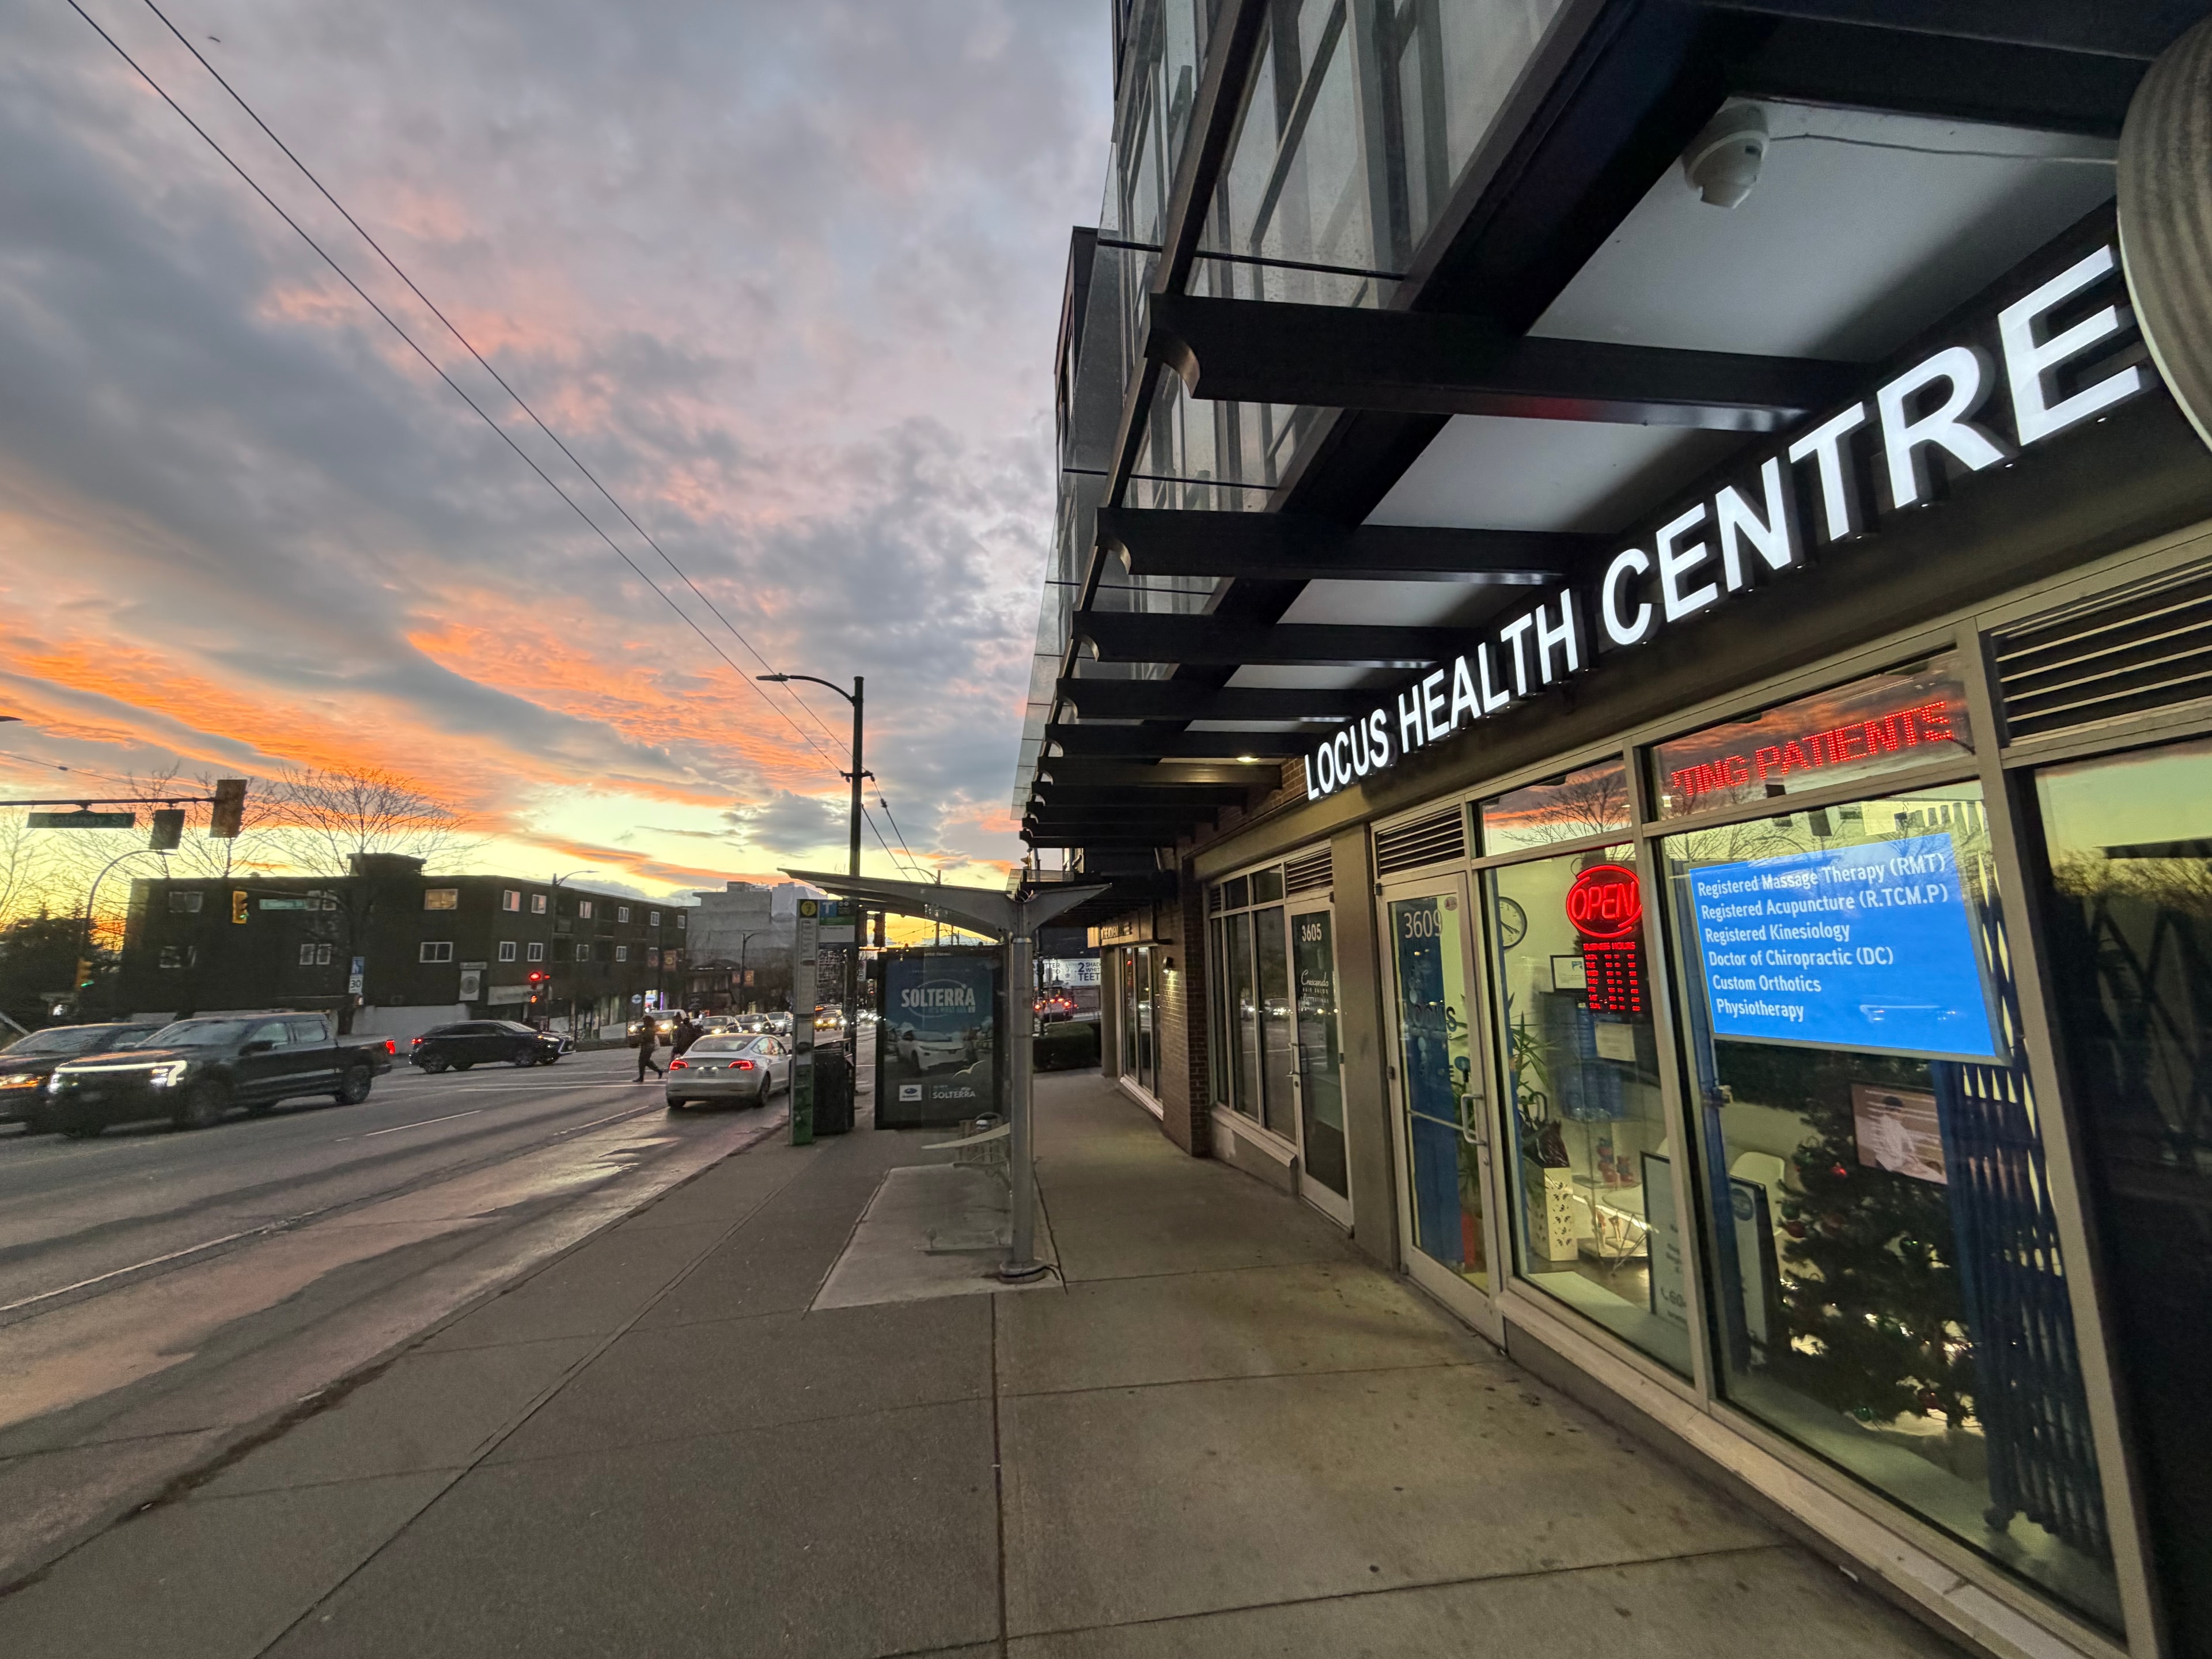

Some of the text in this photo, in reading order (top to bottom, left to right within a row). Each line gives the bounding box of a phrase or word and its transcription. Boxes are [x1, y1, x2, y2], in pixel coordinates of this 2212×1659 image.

[1305, 244, 2141, 800] LOCUS HEALTH CENTRE
[1671, 701, 1952, 797] TING PATIENTS
[1698, 853, 1945, 899] Registered Massage Therapy (RMT)
[1571, 881, 1635, 920] OPEN
[1702, 883, 1948, 922] Registered Acupuncture (R.TCM.P)
[1302, 923, 1322, 942] 3605
[1404, 908, 1443, 939] 3609
[1705, 921, 1850, 945] Registered Kinesiology
[1612, 941, 1637, 950] HOURS
[1078, 962, 1085, 972] 2
[1709, 946, 1893, 969] Doctor of Chiropractic (DC)
[350, 980, 361, 988] 30
[1078, 972, 1101, 981] TEET
[1713, 974, 1821, 992] Custom Orthotics
[901, 987, 976, 1007] SOLTERRA
[1716, 998, 1804, 1022] Physiotherapy
[932, 1090, 976, 1099] SOLTERRA
